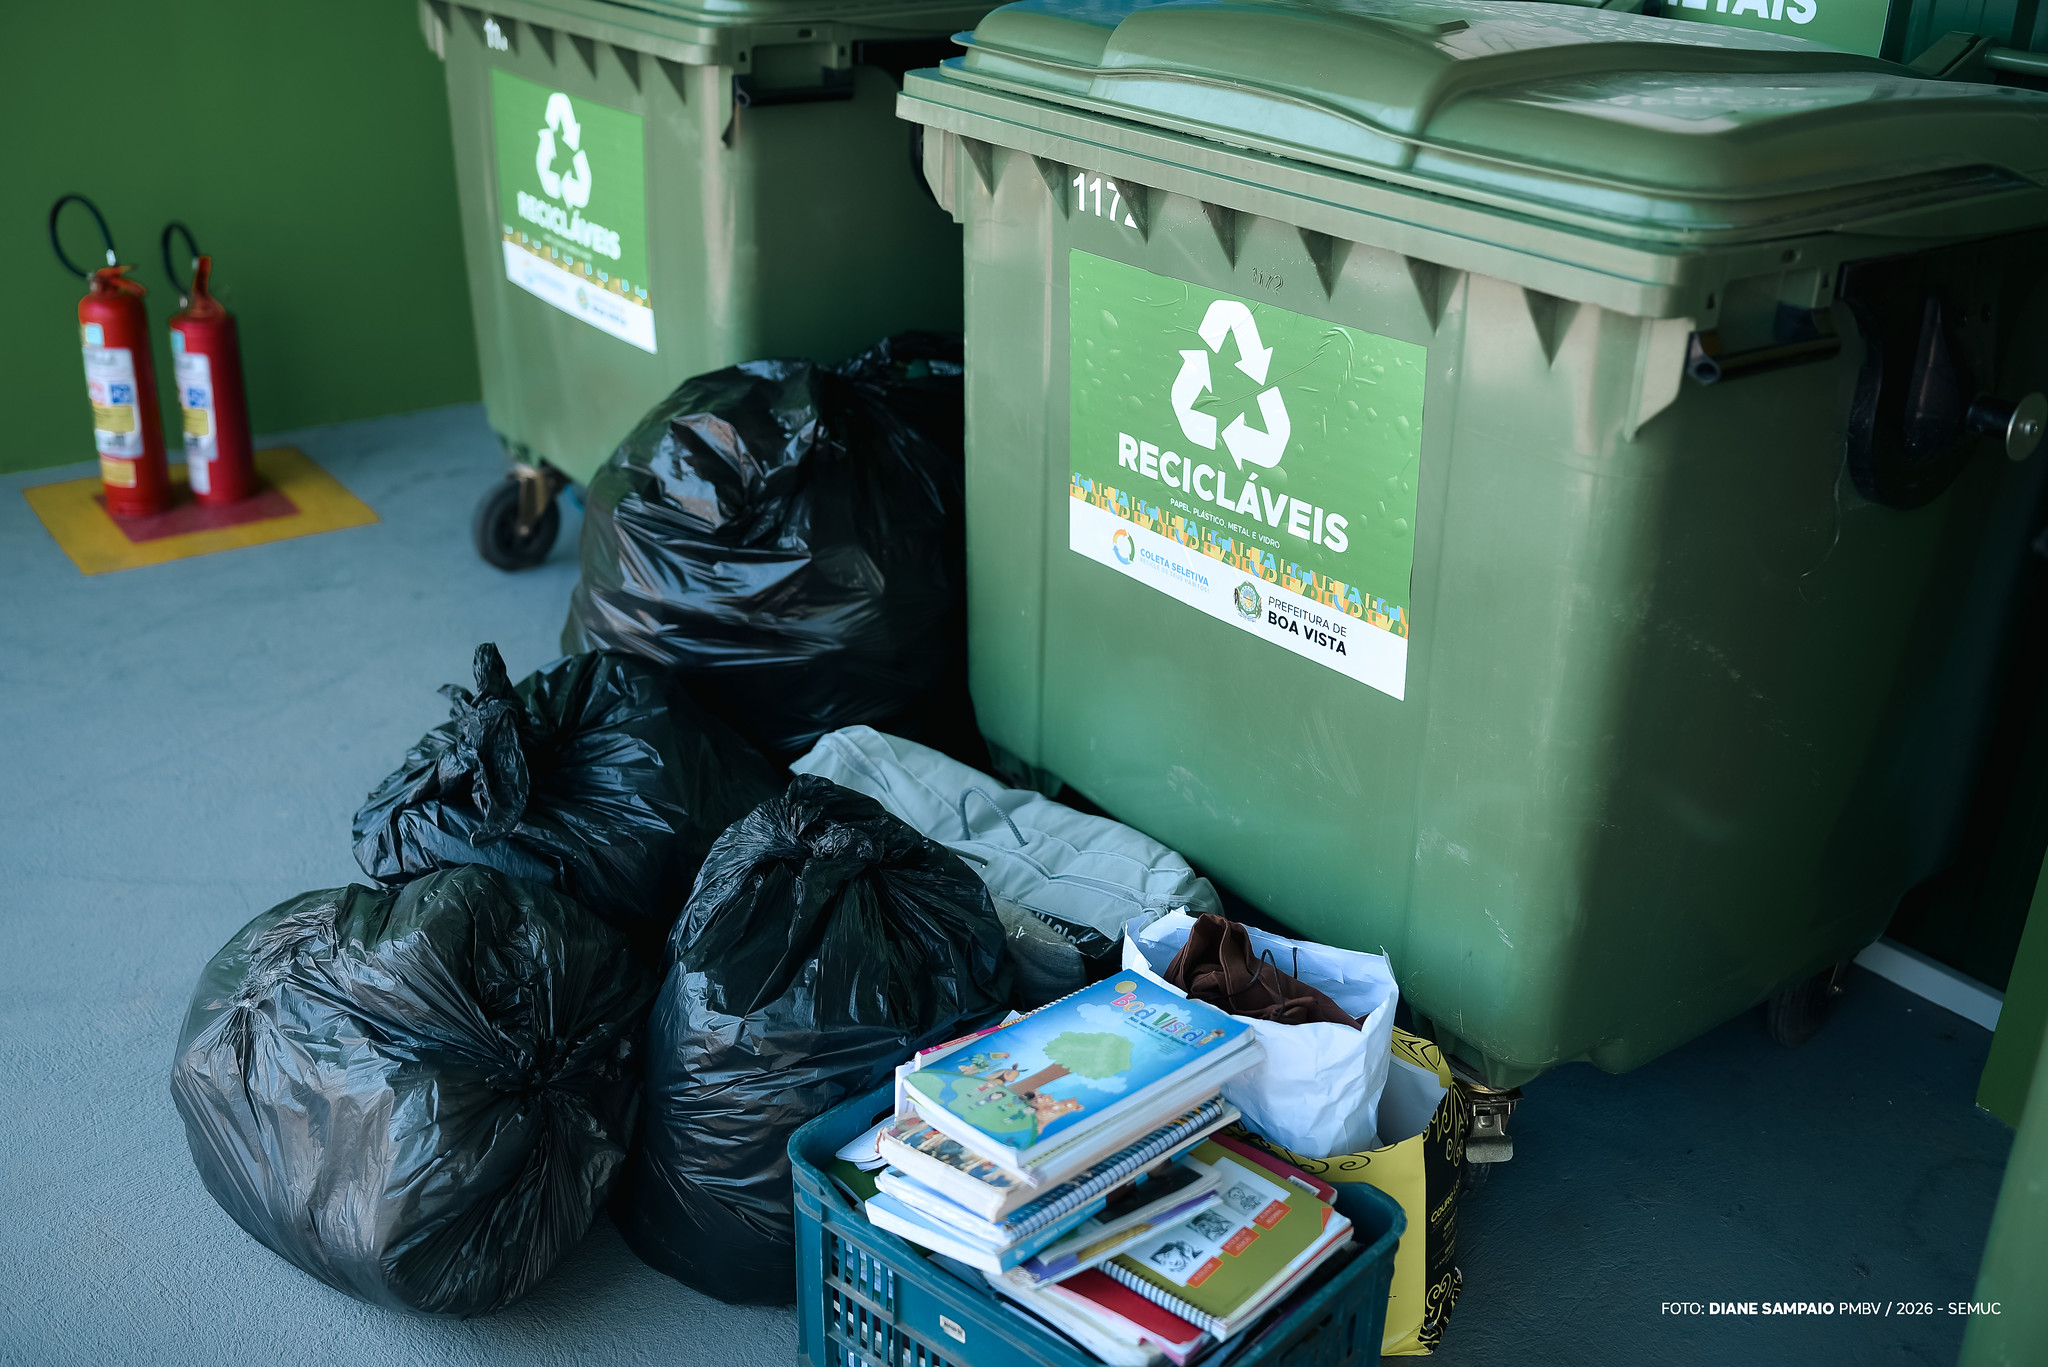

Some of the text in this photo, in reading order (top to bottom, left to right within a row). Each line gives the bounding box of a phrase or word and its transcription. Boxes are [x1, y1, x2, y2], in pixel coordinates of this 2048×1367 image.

[1118, 431, 1349, 553] RECICLÁVEIS
[1170, 498, 1281, 549] PAPEL, PLÁSTICO, METAL E VIDRO
[1140, 548, 1209, 587] COLETA SELETIVA
[1268, 596, 1330, 630] PREFEITURA
[1333, 622, 1347, 638] DE
[1268, 610, 1299, 636] BOA
[1303, 625, 1347, 656] VISTA
